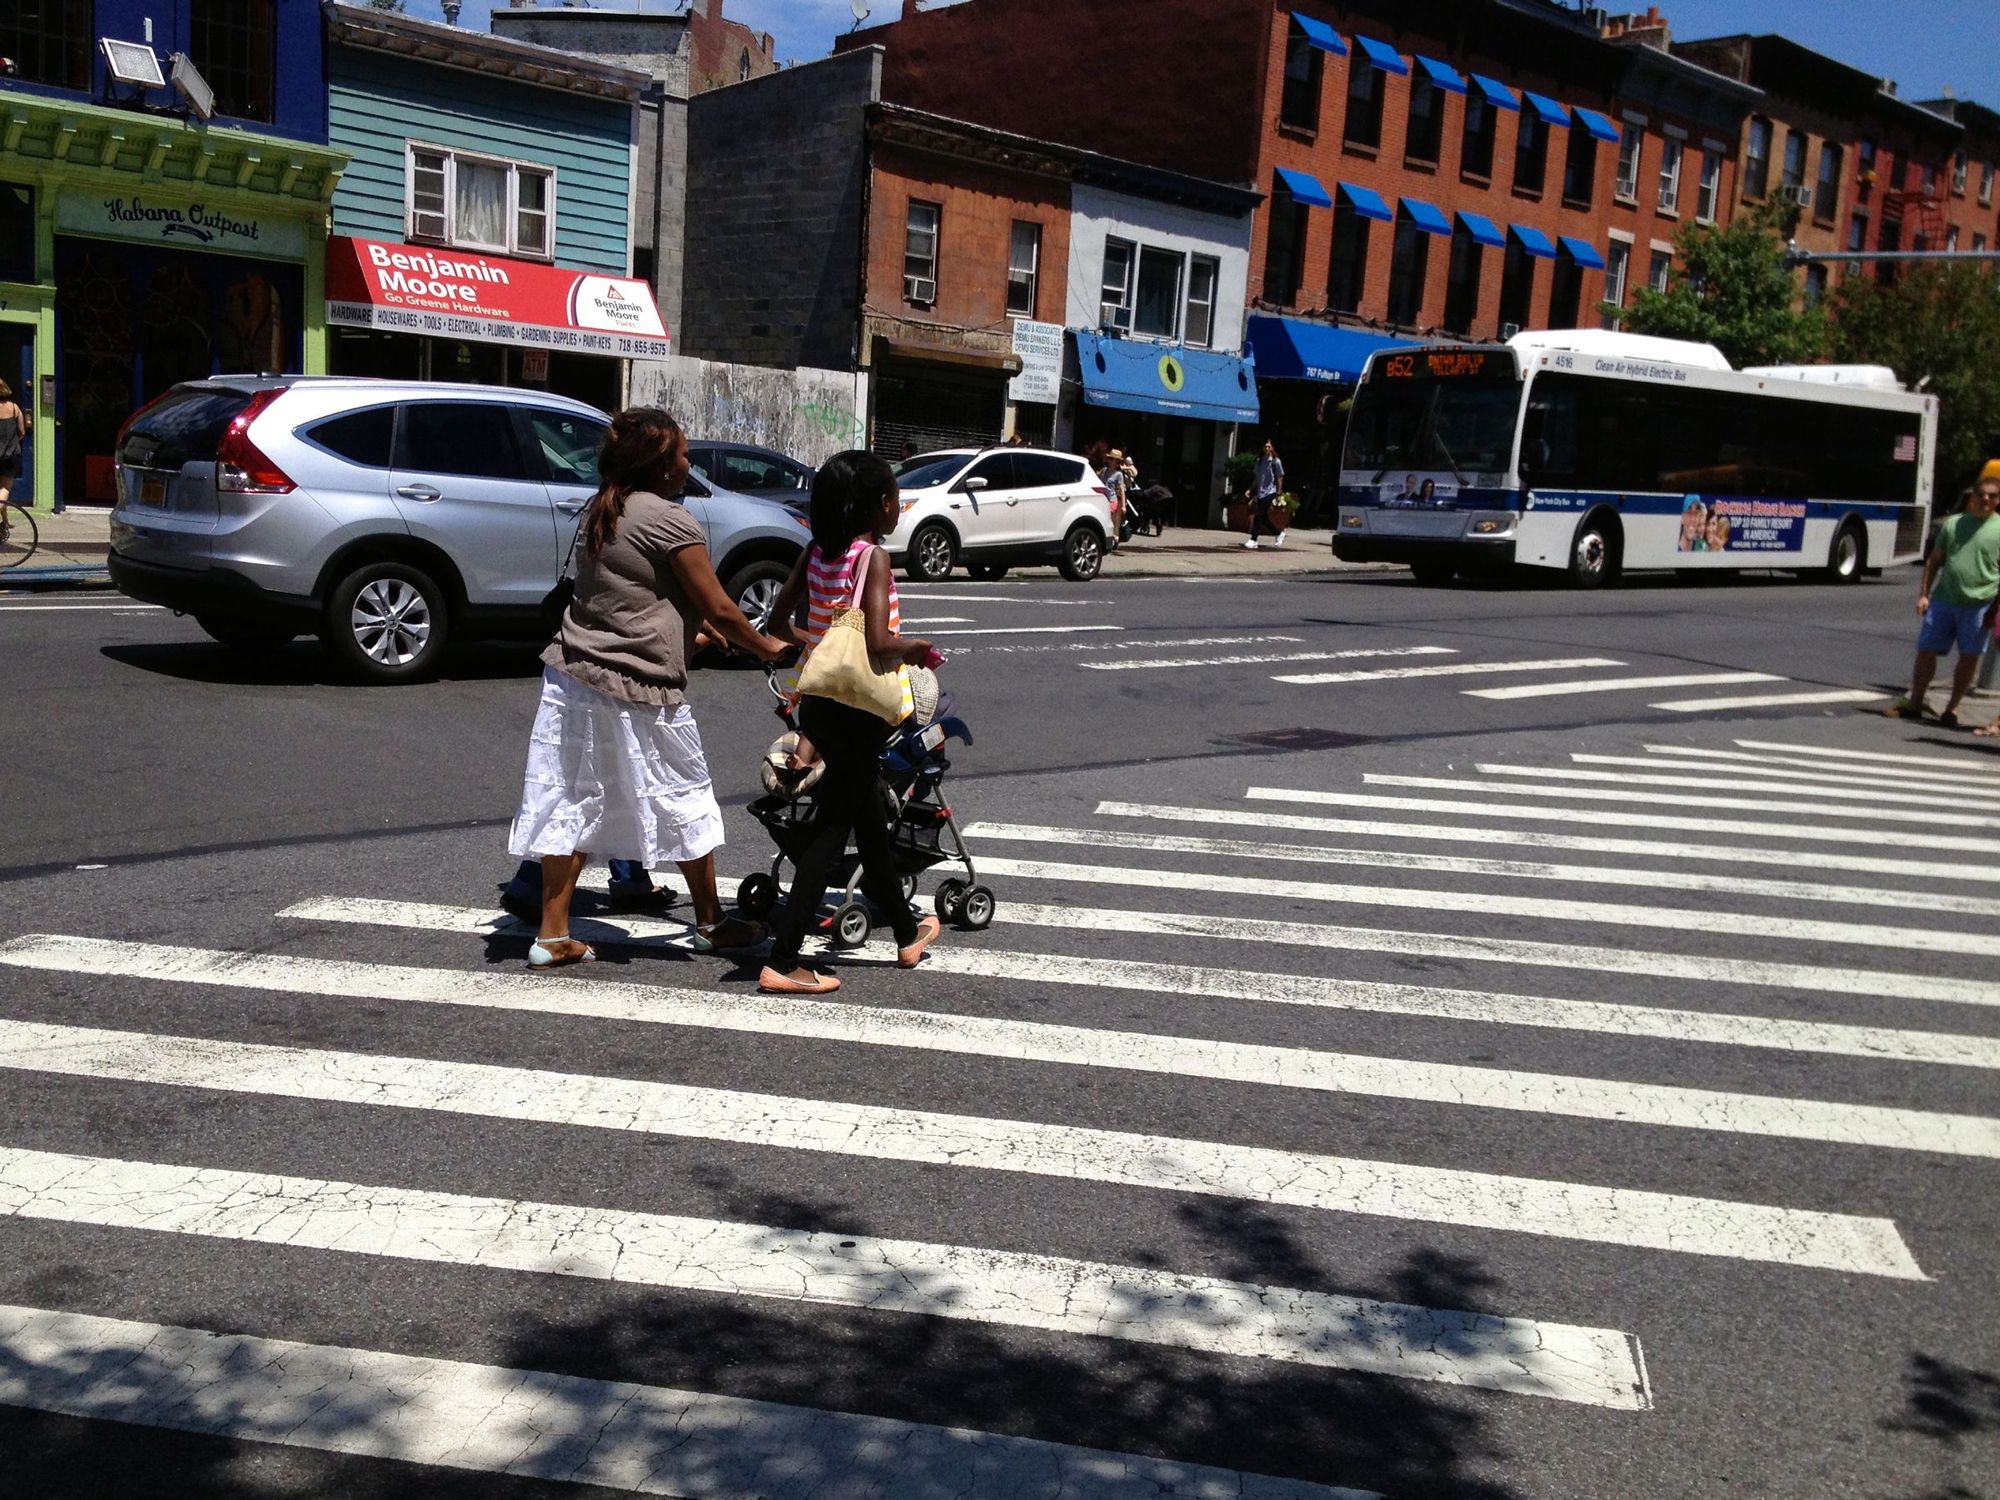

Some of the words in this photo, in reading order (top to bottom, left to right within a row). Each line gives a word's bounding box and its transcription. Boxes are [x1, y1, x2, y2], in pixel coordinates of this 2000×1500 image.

[104, 197, 184, 222] Habana
[189, 203, 258, 240] Outpost
[368, 244, 510, 284] Benjamin
[378, 268, 477, 301] Moore
[331, 304, 372, 322] HARDWARE
[385, 292, 403, 303] Go
[406, 295, 450, 310] Greene
[452, 303, 510, 317] Hardware
[594, 298, 643, 312] Benjamin
[606, 309, 639, 321] Moore
[378, 309, 418, 327] HOUSEWARES
[424, 315, 441, 331] TOOLS
[448, 318, 481, 335] ELECTRICAL
[487, 323, 515, 339] PLUMBING
[521, 327, 551, 342] GARDENING
[553, 331, 577, 345] SUPPLIES
[583, 336, 611, 350] PAINT-KEYS
[619, 338, 666, 355] 718-855-9575
[523, 358, 546, 374] ATM
[1386, 356, 1414, 377] B52
[1555, 356, 1573, 368] 4516
[1595, 359, 1614, 371] Clean
[1615, 362, 1625, 374] Air
[1626, 363, 1648, 377] Hybrid
[1650, 366, 1672, 379] Electric
[1674, 369, 1686, 381] Bus
[1318, 368, 1333, 380] Fulton
[1335, 372, 1340, 380] St
[1730, 516, 1742, 528] TOP
[1742, 517, 1750, 528] 10
[1750, 517, 1771, 529] FAMILY
[1771, 517, 1793, 529] RESORT
[1743, 529, 1750, 540] IN
[1750, 529, 1778, 540] AMERICA!
